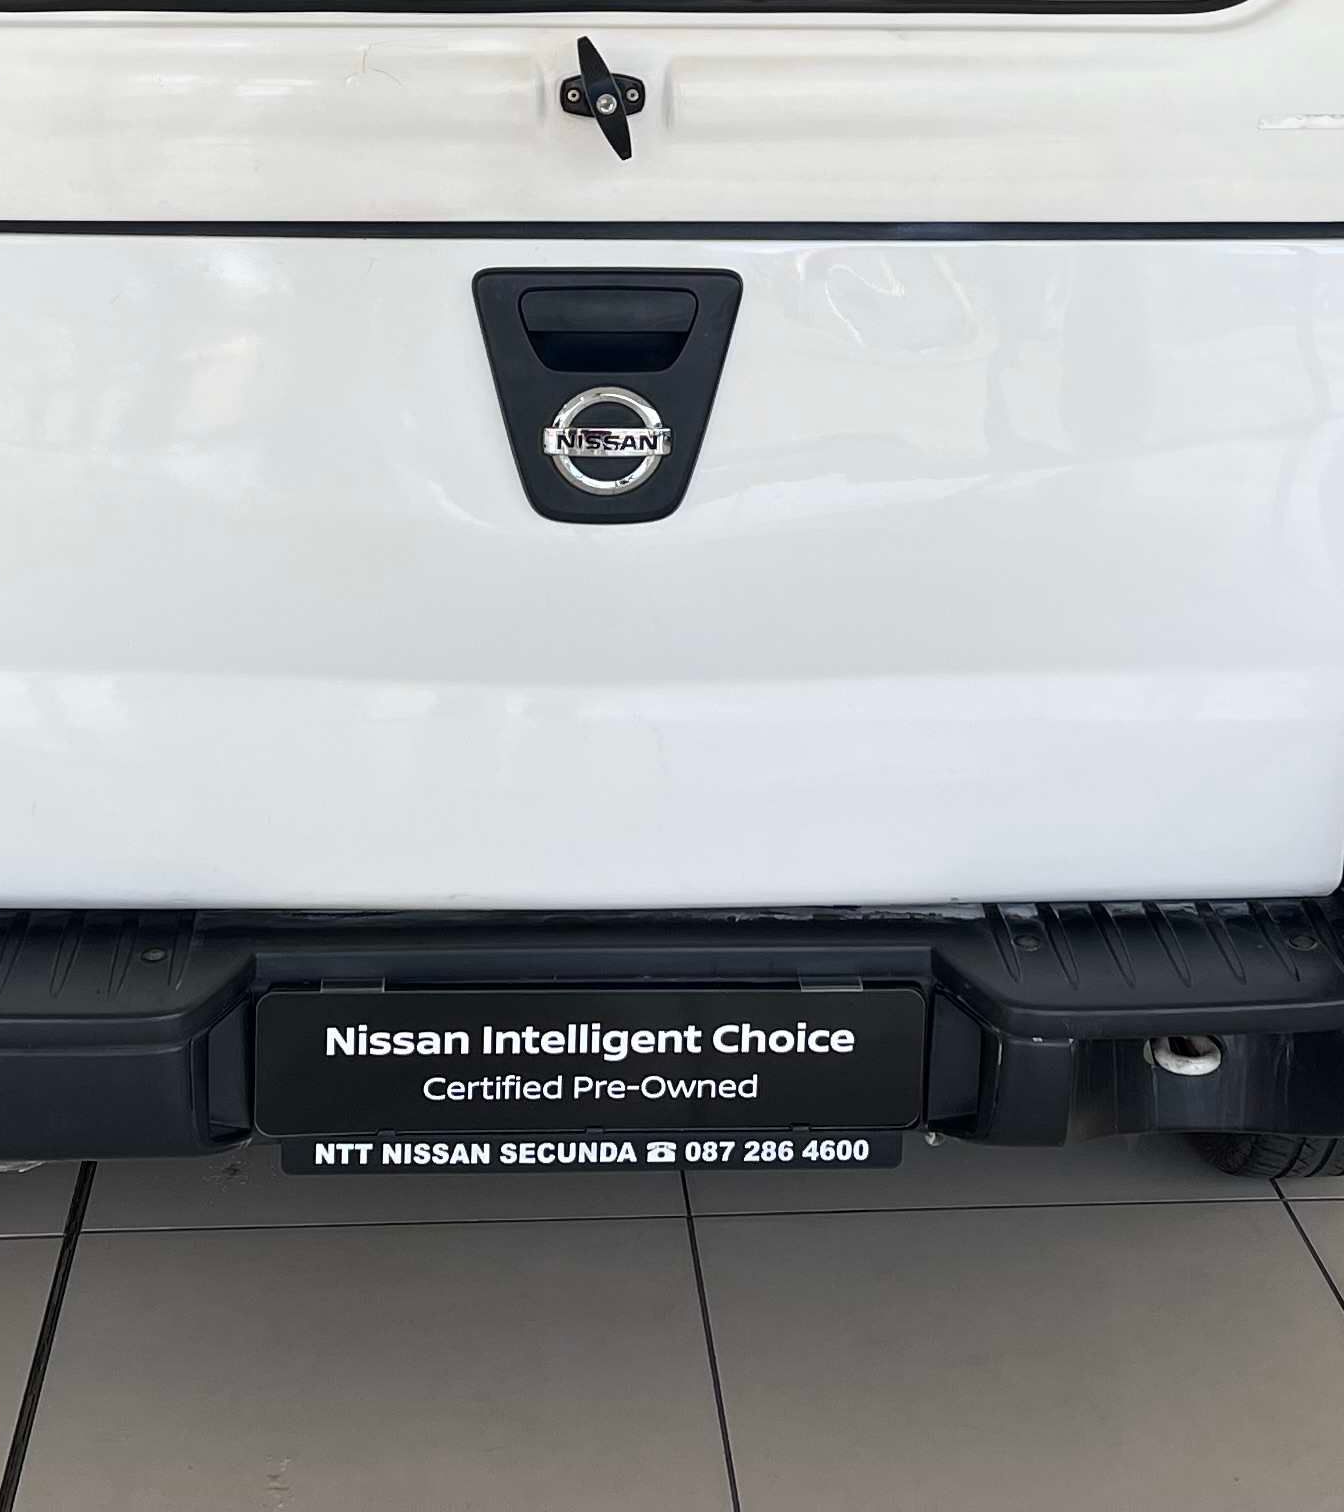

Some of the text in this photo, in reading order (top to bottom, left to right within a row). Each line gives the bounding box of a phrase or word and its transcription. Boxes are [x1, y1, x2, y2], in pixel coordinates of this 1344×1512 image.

[557, 434, 657, 451] NISSAN
[325, 1021, 855, 1062] Nissan Intelligent Choice
[422, 1073, 759, 1101] Certified Pre-Owned
[314, 1138, 870, 1165] NTT NISSAN SECUNDA 087 286 4600
